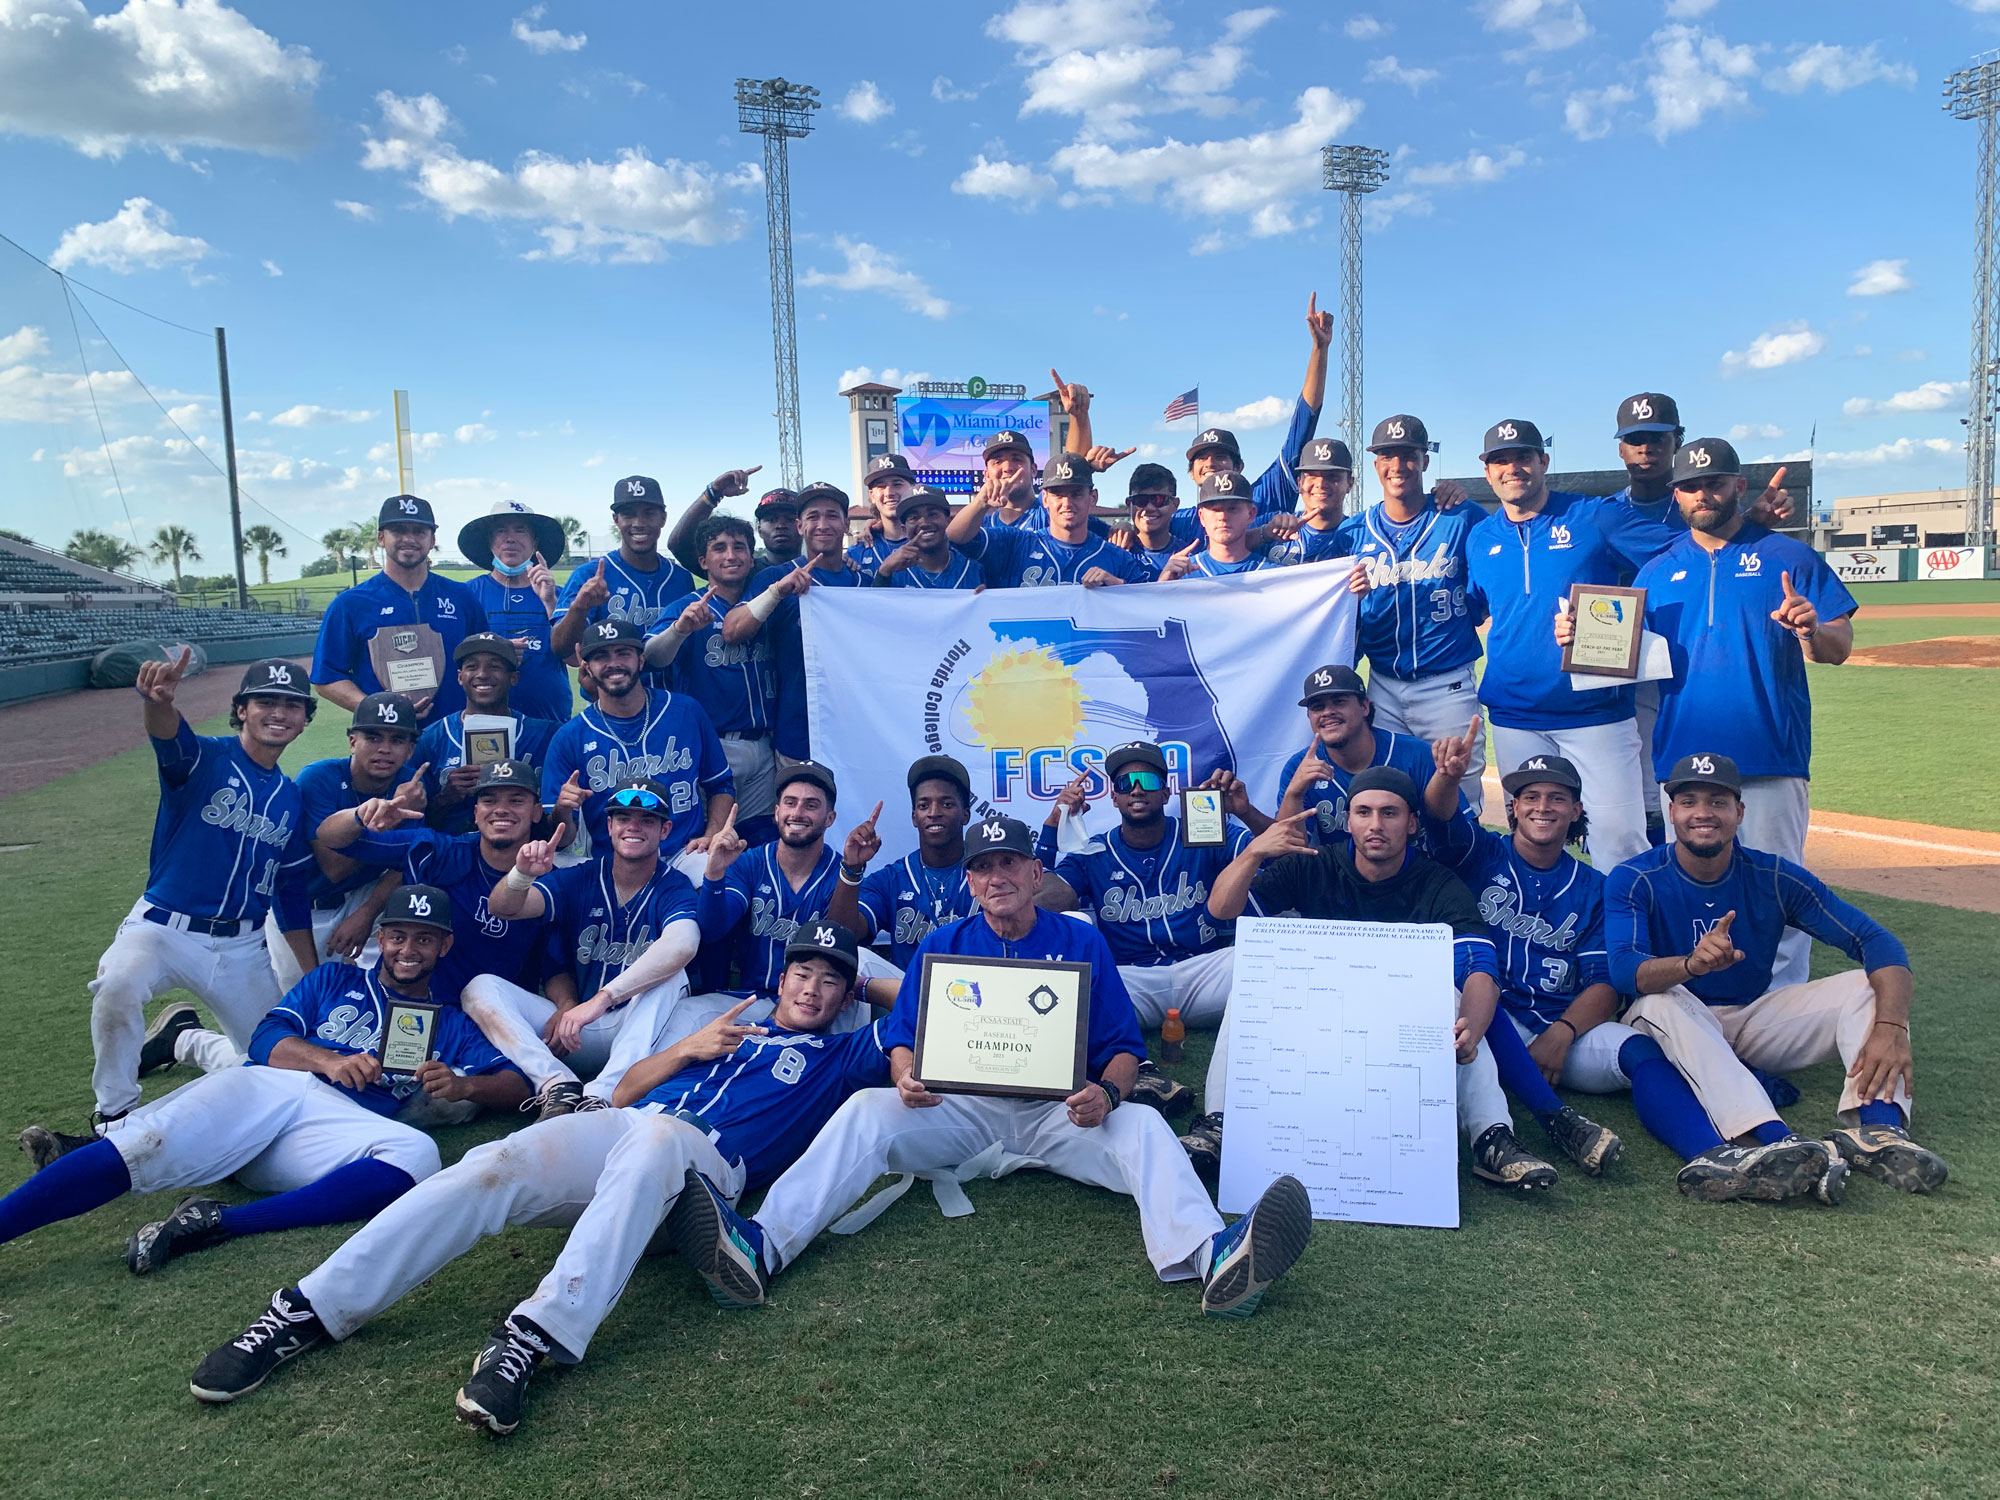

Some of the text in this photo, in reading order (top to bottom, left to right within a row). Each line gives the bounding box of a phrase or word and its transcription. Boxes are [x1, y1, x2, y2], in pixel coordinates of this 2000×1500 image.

[917, 381, 964, 393] PUBLIX
[990, 384, 1026, 395] FIELD
[1632, 398, 1654, 420] MD
[953, 414, 1043, 430] Miami Dade
[1387, 421, 1405, 439] MD
[872, 427, 885, 437] Lite
[1203, 430, 1219, 443] MD
[1498, 423, 1518, 440] MD
[1315, 444, 1331, 461] MD
[1689, 447, 1711, 468] MD
[1056, 462, 1073, 480] MD
[628, 480, 646, 497] MD
[1215, 473, 1233, 492] MD
[399, 499, 418, 515] MD
[1551, 524, 1571, 544] MD
[1739, 552, 1761, 572] MD
[1928, 549, 1960, 570] AAA
[1838, 566, 1887, 576] POLK
[437, 597, 456, 615] MD
[1430, 588, 1468, 622] 39
[599, 622, 618, 639] MD
[268, 665, 291, 685] MD
[1314, 669, 1333, 687] MD
[924, 638, 972, 753] Florida College
[378, 703, 399, 724] MD
[492, 762, 514, 778] MD
[587, 736, 693, 792] Sharks
[991, 740, 1193, 802] FCSA
[1691, 756, 1715, 775] MD
[982, 821, 1006, 842] MD
[409, 894, 432, 917] MD
[1100, 872, 1208, 923] Sharks
[814, 926, 837, 949] MD
[980, 1016, 1002, 1024] FCSAA
[983, 1031, 1017, 1040] BASEBALL
[967, 1040, 1032, 1053] CHAMPION
[771, 1047, 807, 1085] 8
